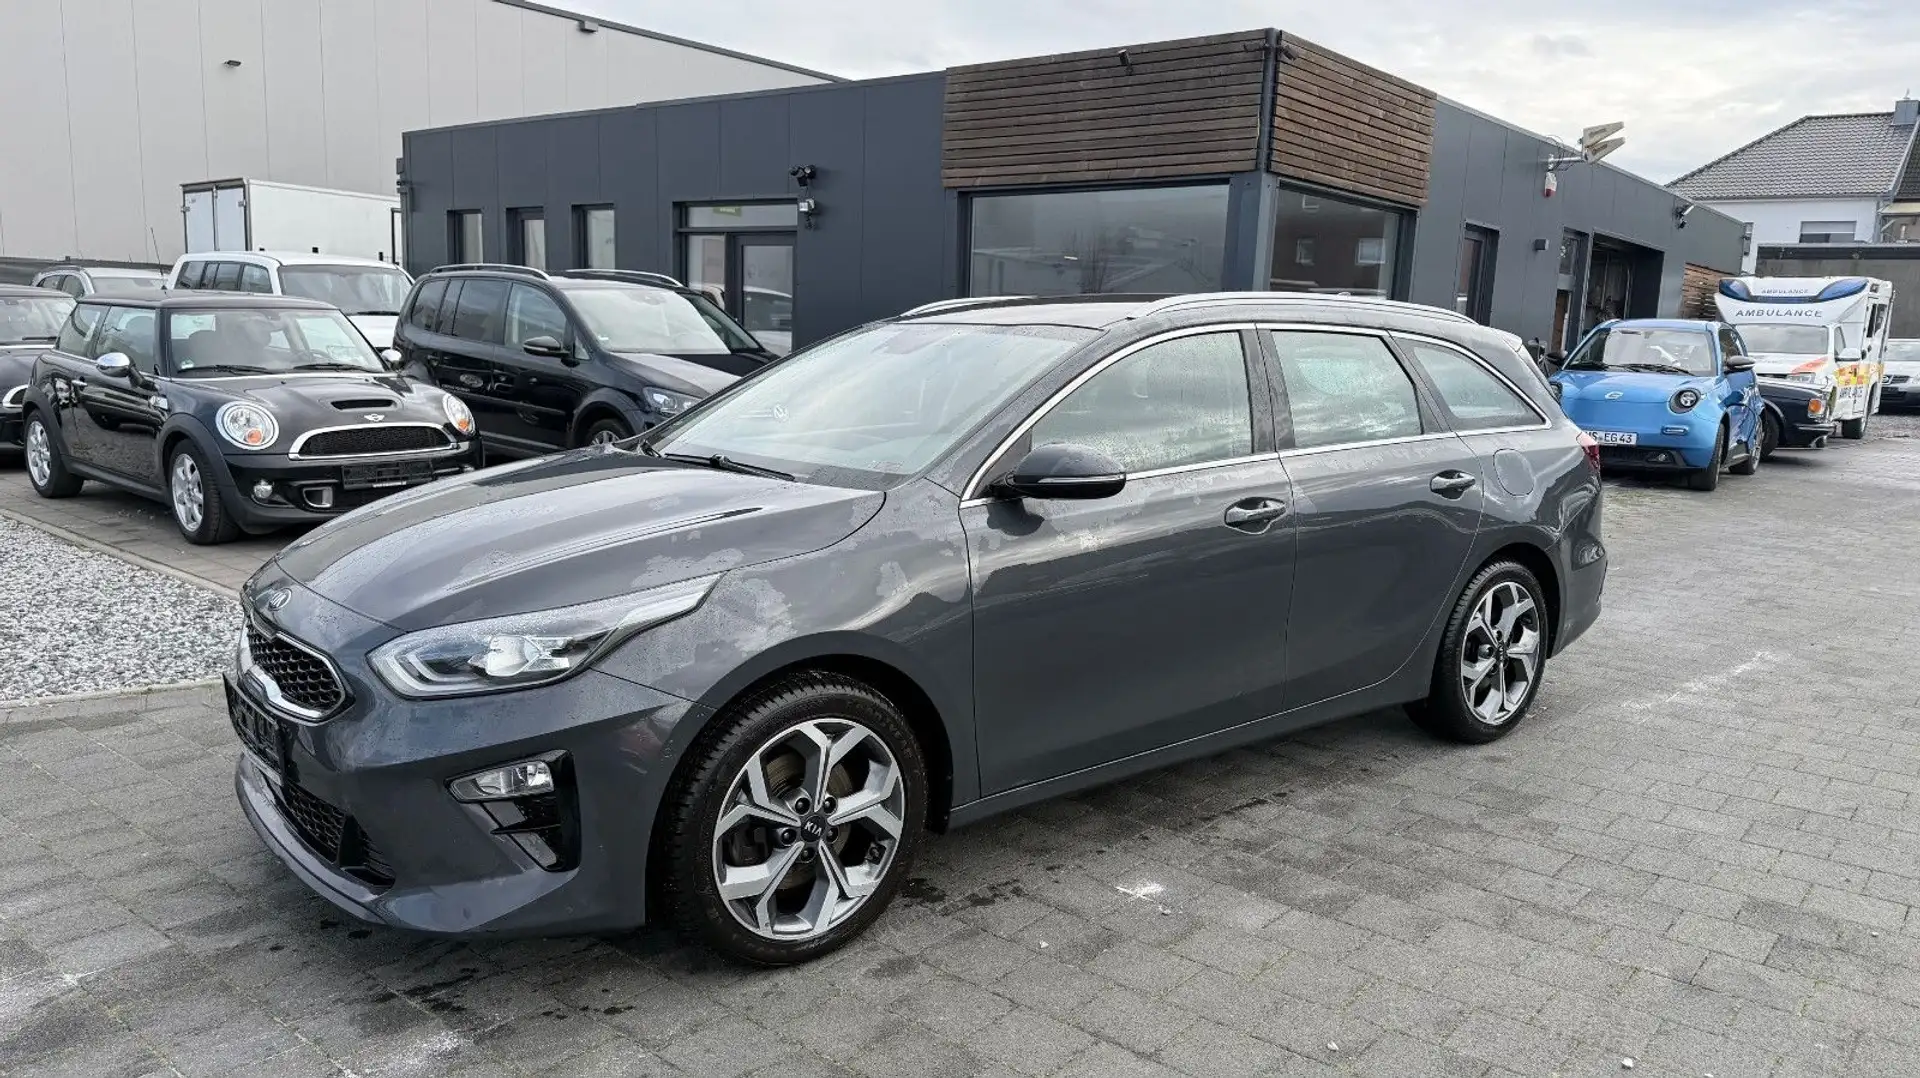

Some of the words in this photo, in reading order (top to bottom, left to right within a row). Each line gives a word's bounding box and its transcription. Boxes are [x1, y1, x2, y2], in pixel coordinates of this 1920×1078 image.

[1735, 309, 1822, 317] AMBULANCE
[1604, 433, 1617, 442] EG
[1619, 434, 1632, 443] 43
[804, 821, 822, 836] KIA
